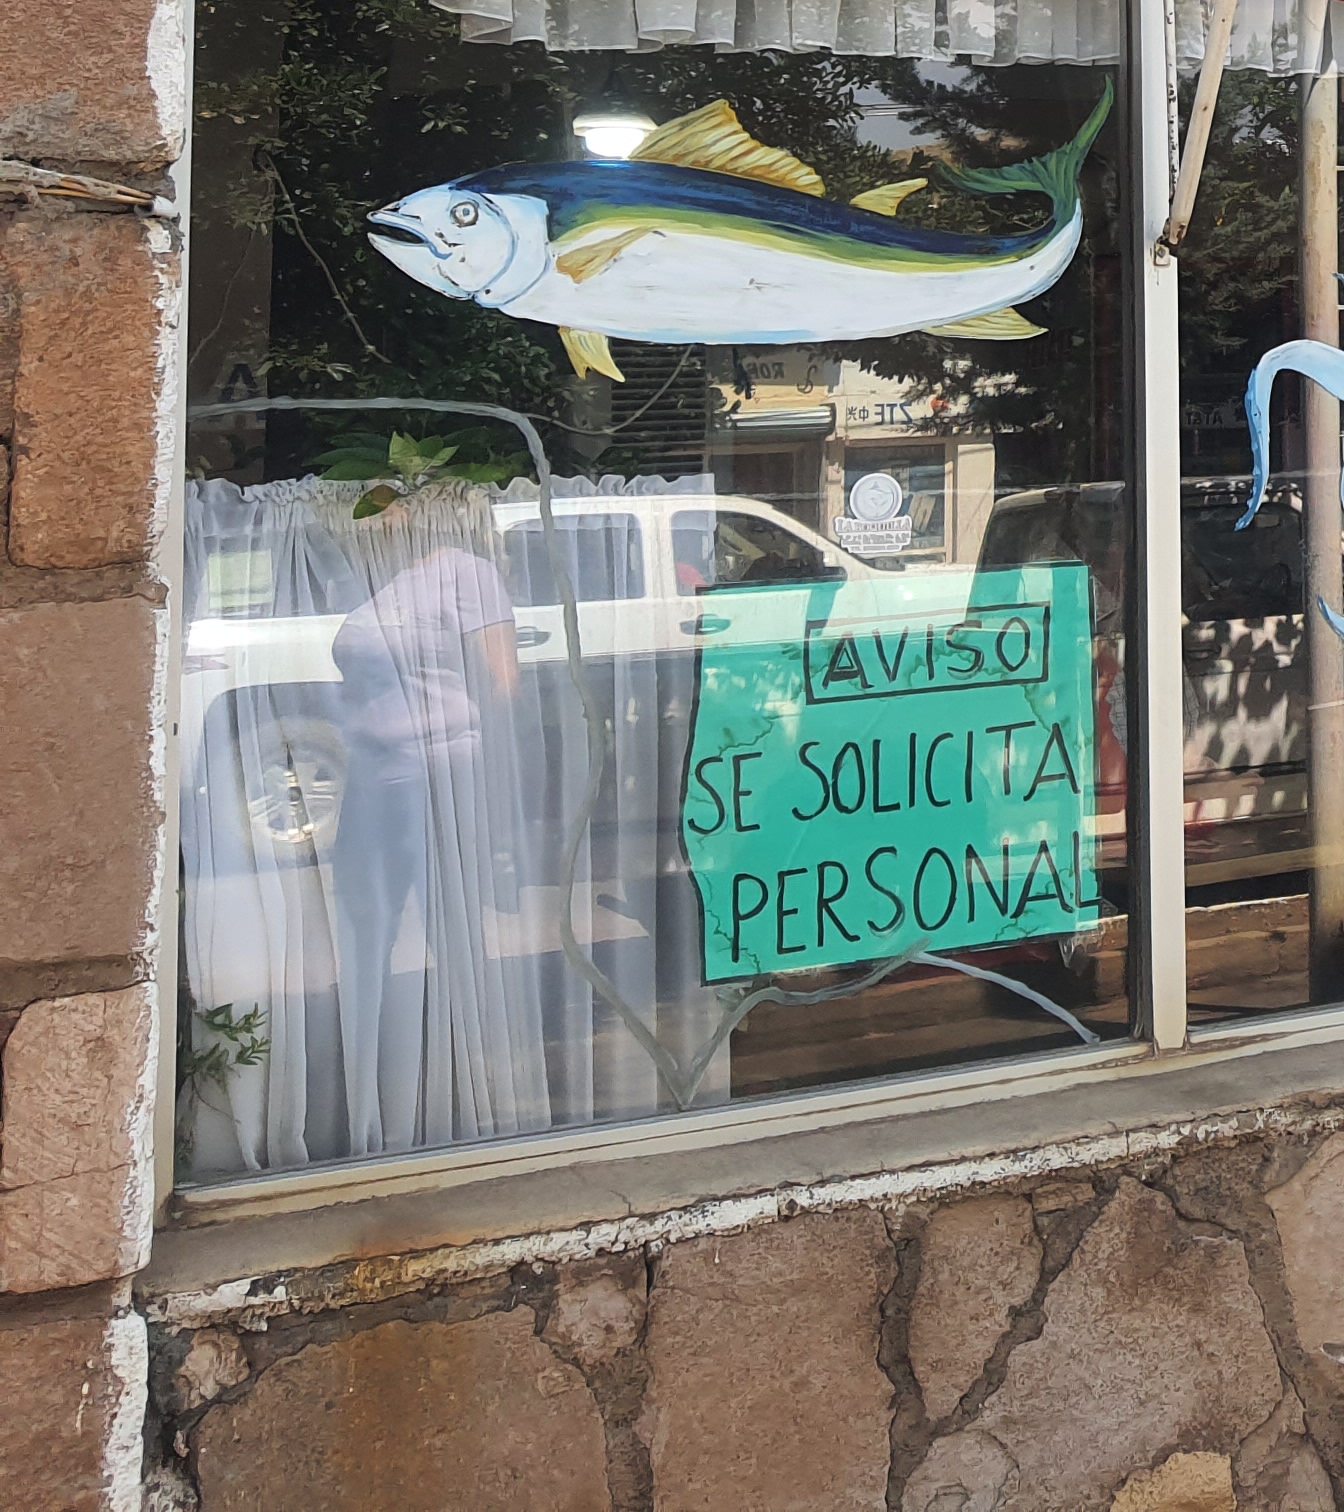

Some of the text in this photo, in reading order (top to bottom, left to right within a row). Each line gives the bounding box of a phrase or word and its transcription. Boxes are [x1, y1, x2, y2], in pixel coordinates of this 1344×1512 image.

[820, 615, 1032, 691] AVISO
[687, 719, 1081, 838] SE SOLICITA
[730, 829, 1102, 964] PERSONAL
